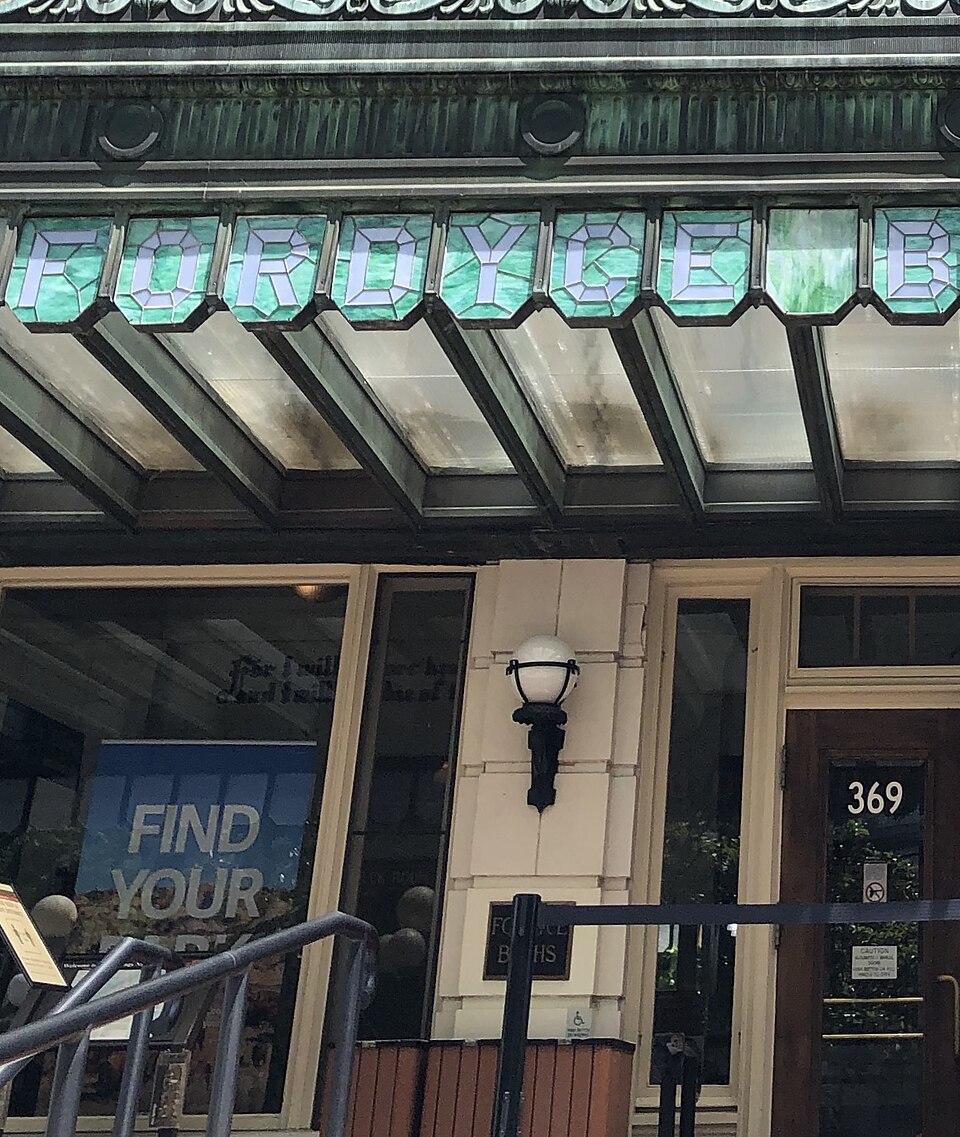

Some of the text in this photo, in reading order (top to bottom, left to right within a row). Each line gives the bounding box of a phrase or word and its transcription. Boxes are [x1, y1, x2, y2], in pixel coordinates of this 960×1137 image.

[17, 222, 740, 307] FORDYCE
[847, 781, 903, 814] 369
[128, 804, 260, 853] FIND
[111, 868, 264, 919] YOUR
[497, 944, 557, 964] BHS
